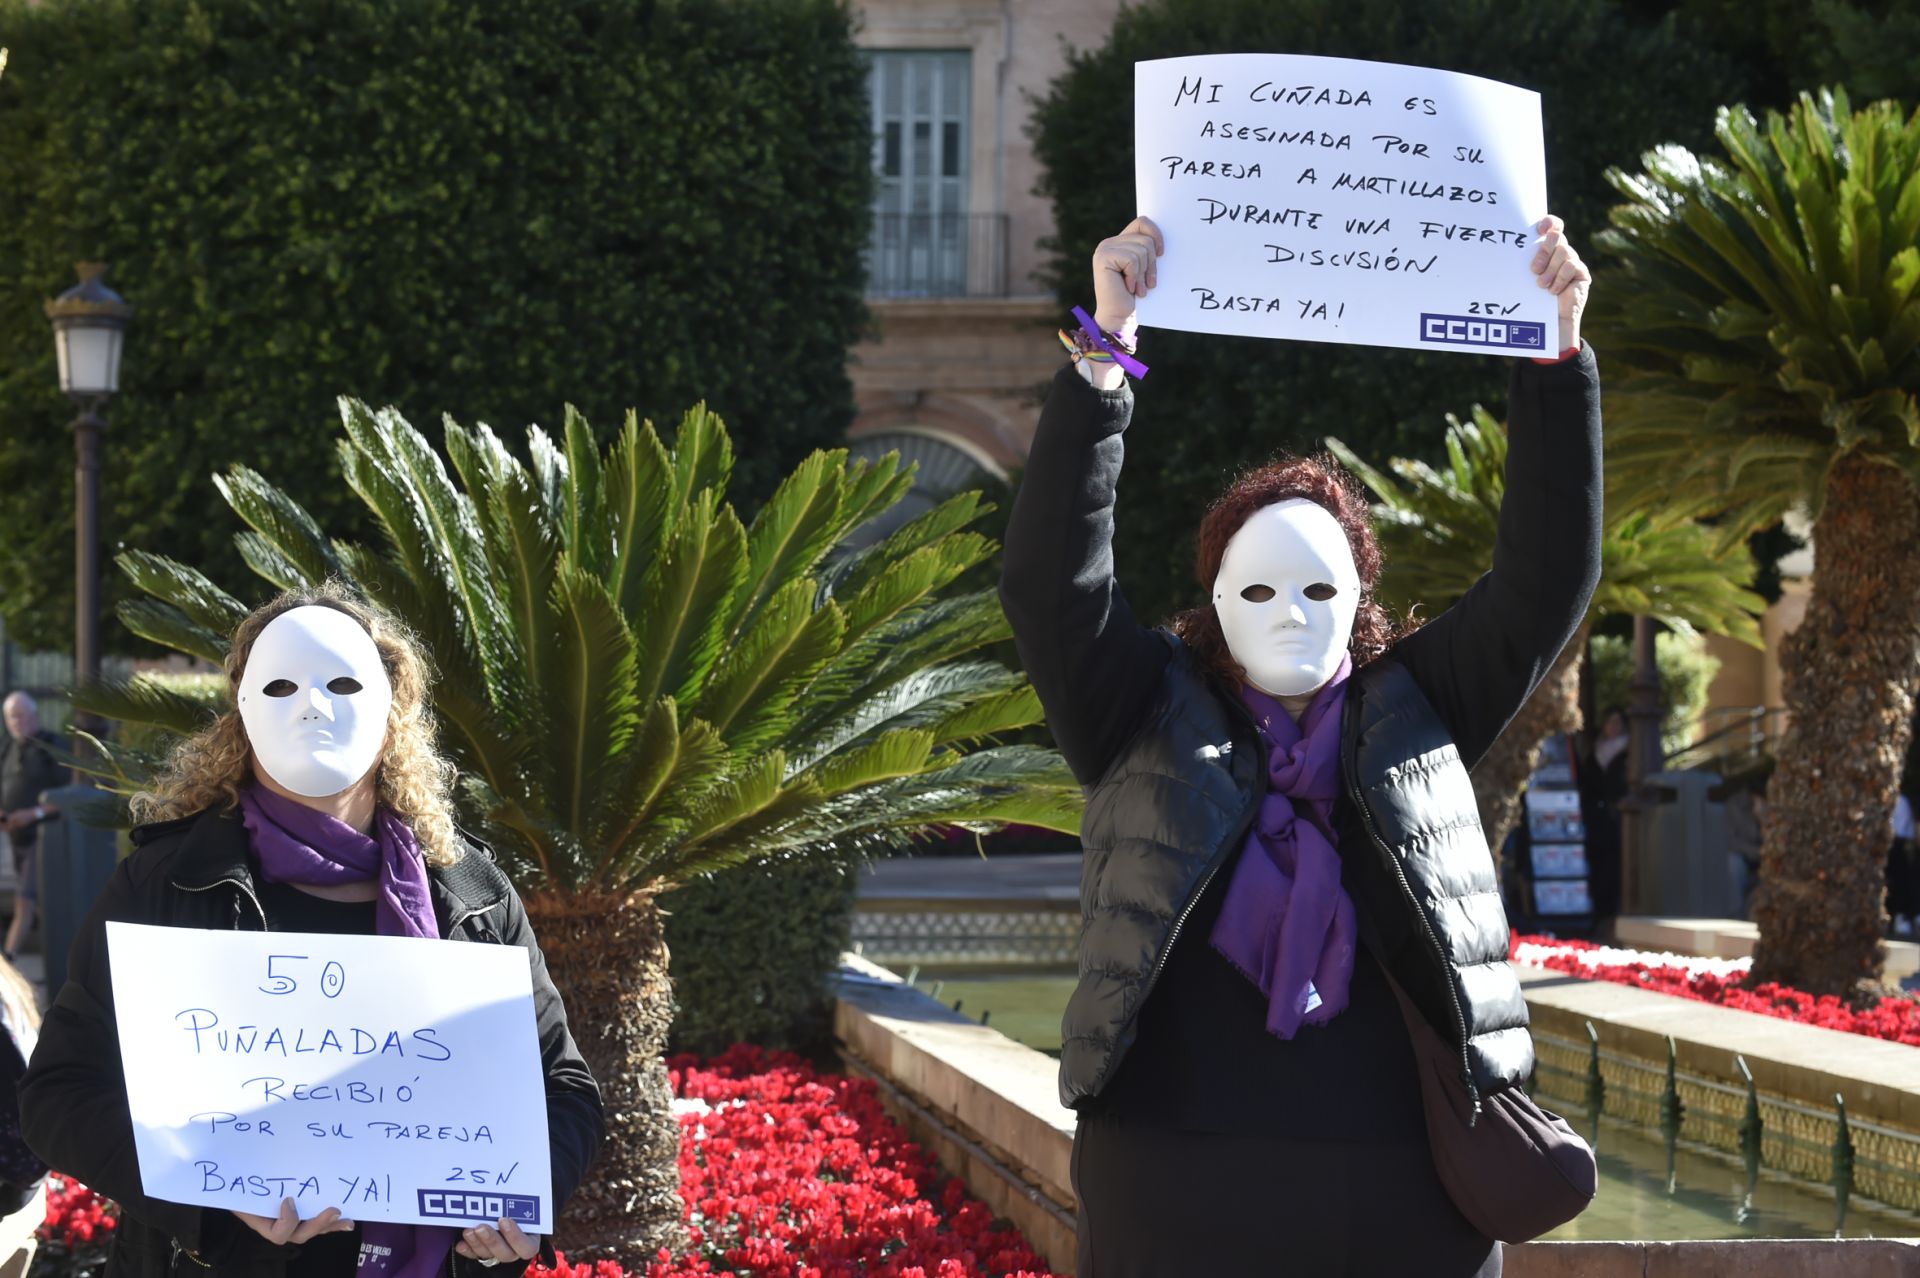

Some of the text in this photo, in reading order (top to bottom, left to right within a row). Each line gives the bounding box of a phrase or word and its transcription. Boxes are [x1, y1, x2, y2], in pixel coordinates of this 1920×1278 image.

[1174, 75, 1438, 116] MI CUÑADA ES
[1200, 120, 1485, 164] ASESINADA POR SU
[1160, 156, 1498, 205] PAREJA A MARTILLAZOS
[1197, 198, 1528, 249] DURANTE UNA FUERTE
[1264, 244, 1439, 274] DISCUSIÓN
[1191, 287, 1345, 328] BASTA YA!
[1468, 301, 1522, 317] 25N
[1425, 318, 1507, 344] CCOO
[258, 955, 346, 999] 50
[175, 1008, 452, 1062] PUÑALADAS
[241, 1076, 420, 1104] RECIBIÓ
[189, 1111, 493, 1145] POR SU PAREJA
[194, 1160, 391, 1213] BASTA YA!
[445, 1161, 519, 1186] 25N
[423, 1193, 504, 1218] CCOO
